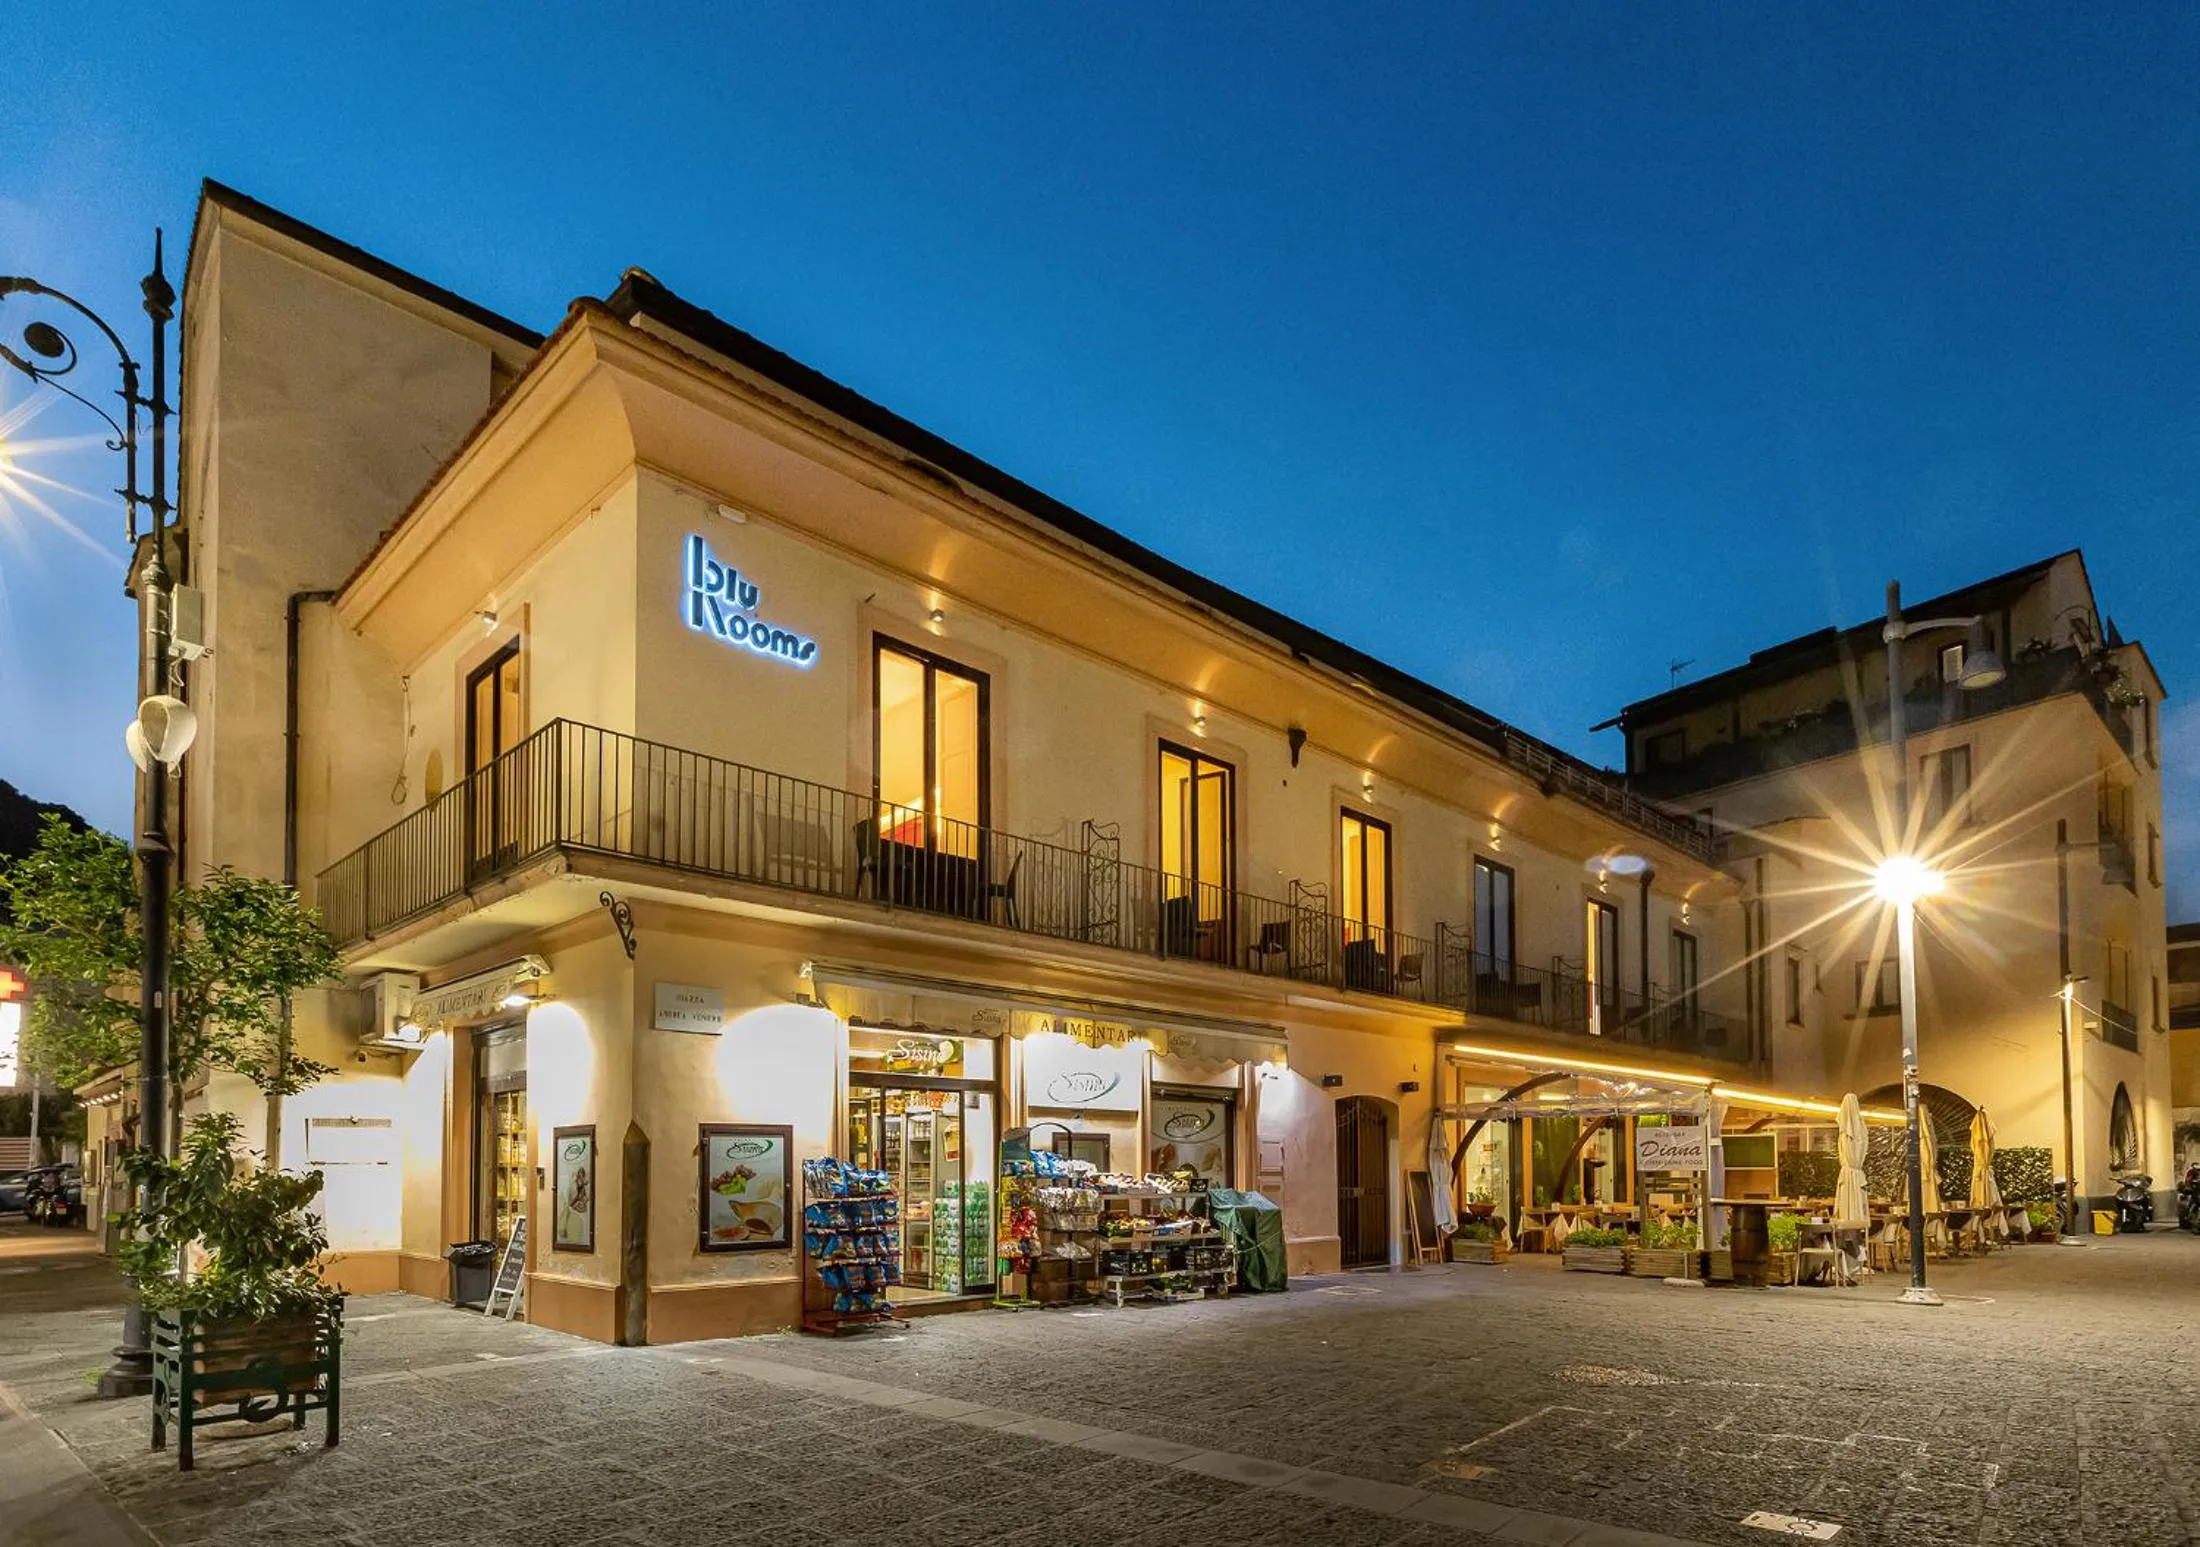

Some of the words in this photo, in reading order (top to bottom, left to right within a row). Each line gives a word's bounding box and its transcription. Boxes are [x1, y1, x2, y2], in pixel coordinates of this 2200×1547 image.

[691, 589, 816, 661] Rooms
[676, 994, 704, 1004] PIAZZA
[1041, 1019, 1143, 1042] ALIMENTARI
[1640, 1140, 1702, 1157] Diana
